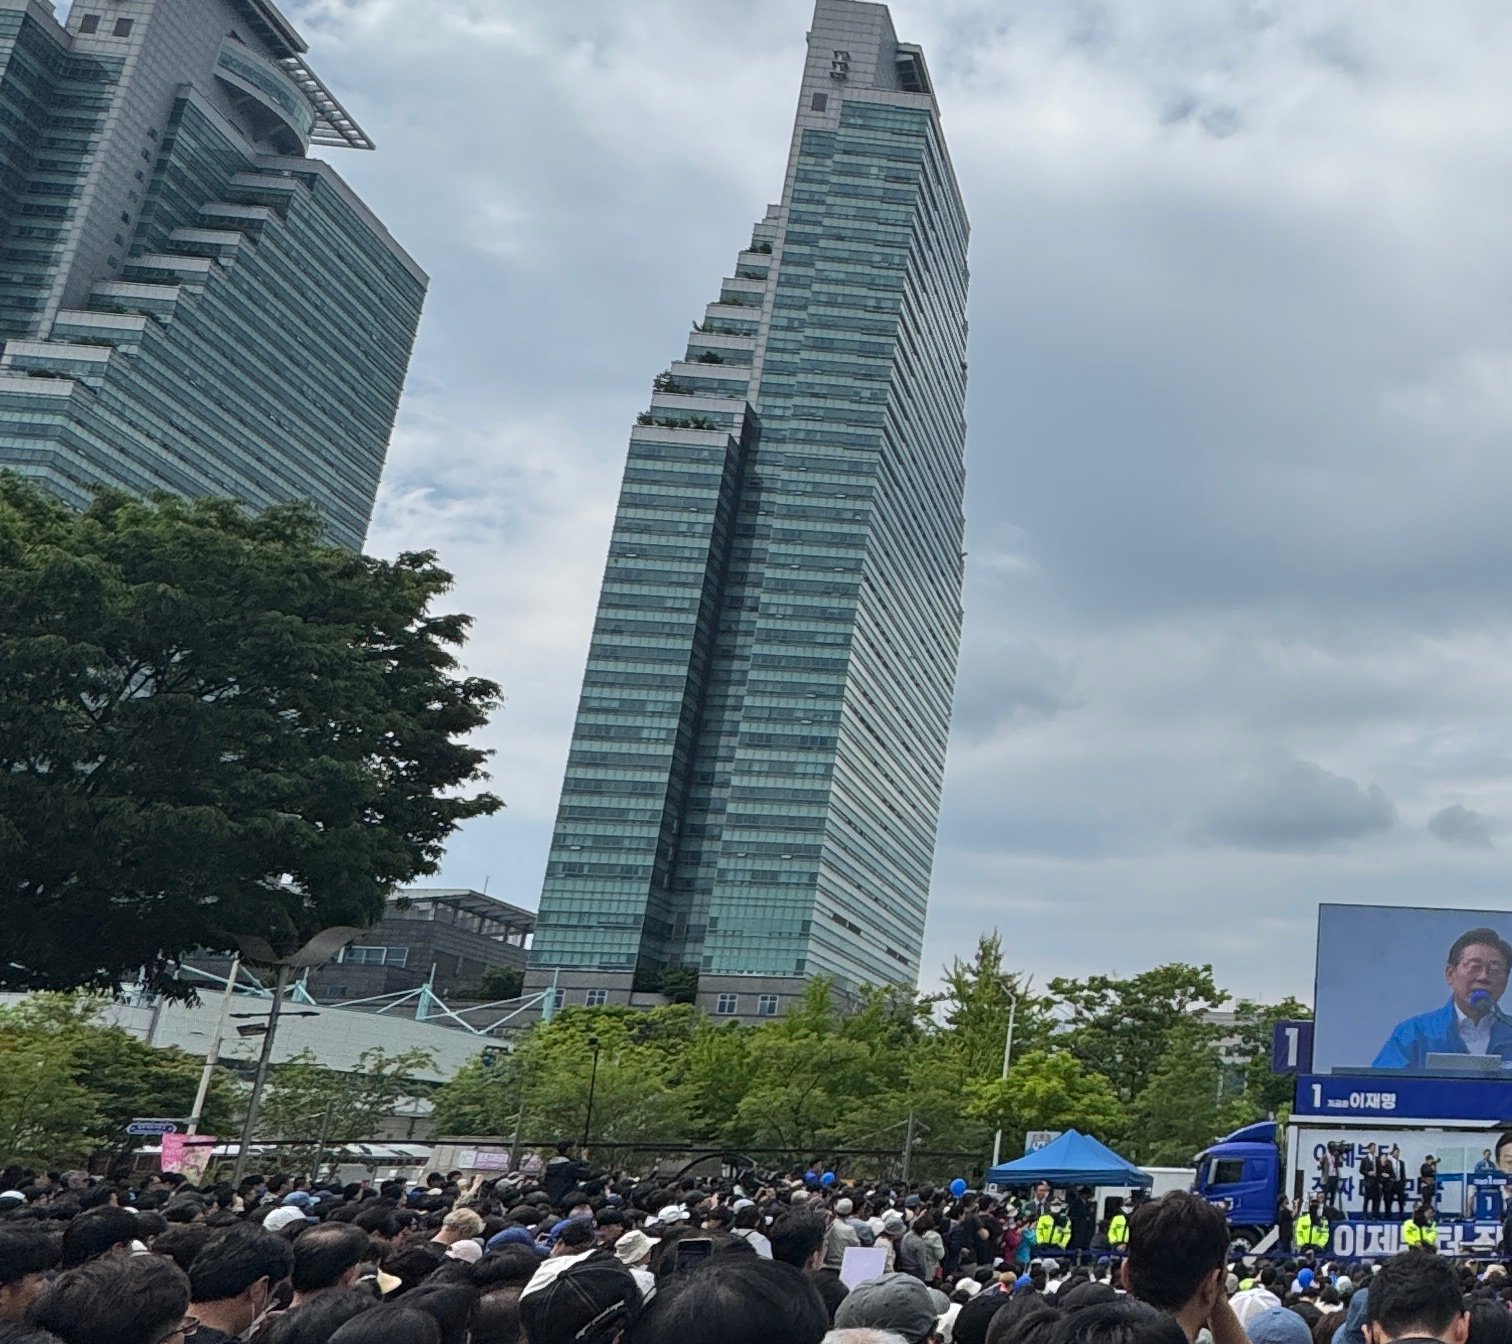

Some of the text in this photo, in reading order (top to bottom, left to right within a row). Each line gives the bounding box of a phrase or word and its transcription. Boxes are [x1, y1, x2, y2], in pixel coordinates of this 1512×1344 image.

[1285, 1027, 1299, 1067] 1
[1311, 1083, 1322, 1108] 1
[1350, 1092, 1397, 1110] 이재명
